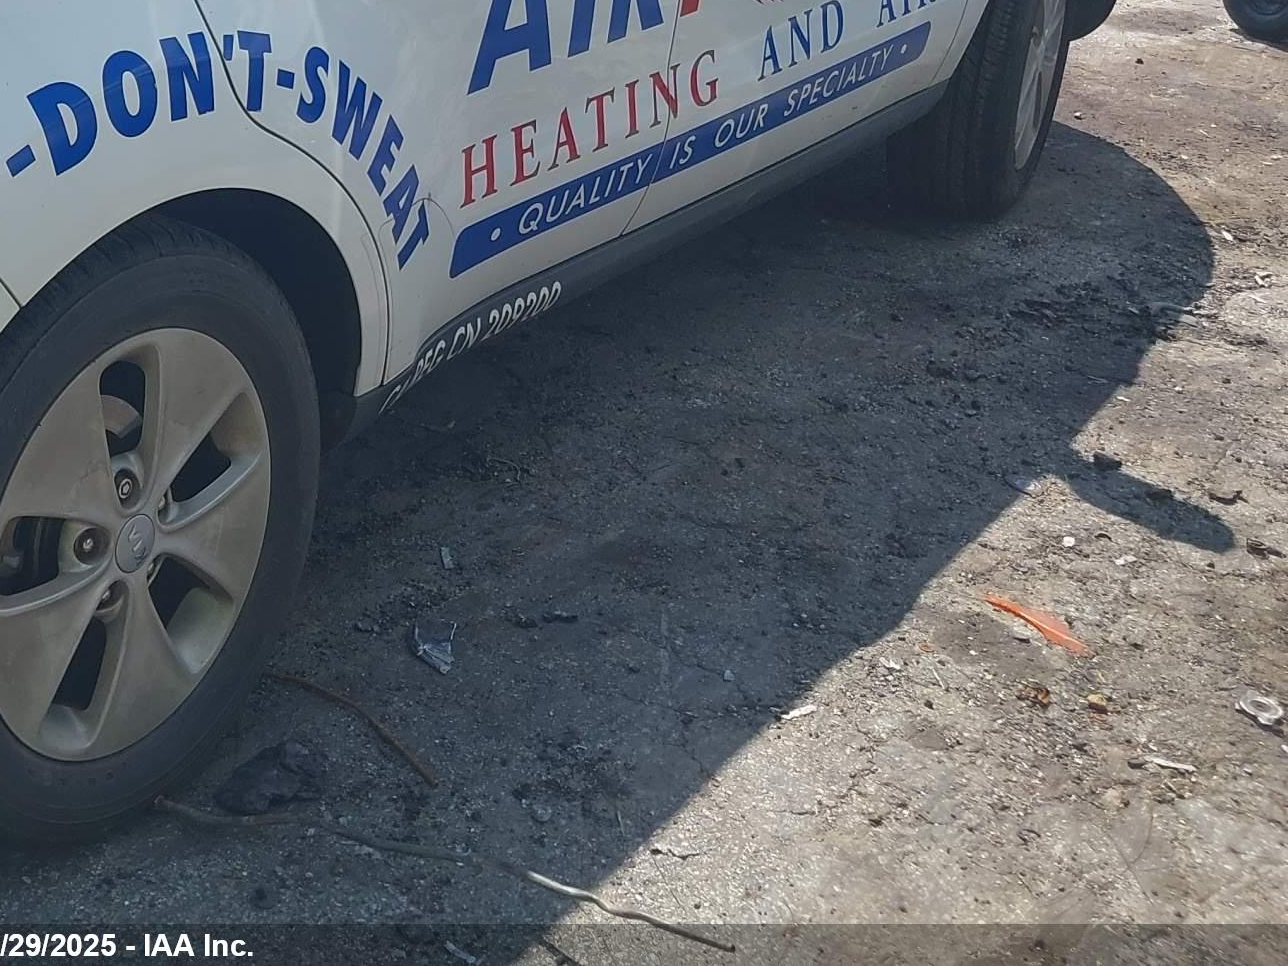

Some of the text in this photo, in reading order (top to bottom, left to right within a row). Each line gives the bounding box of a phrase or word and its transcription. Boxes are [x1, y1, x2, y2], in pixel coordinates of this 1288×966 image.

[460, 49, 720, 208] HEATING
[518, 45, 893, 235] QUALITY IS OUR SPECIALTY
